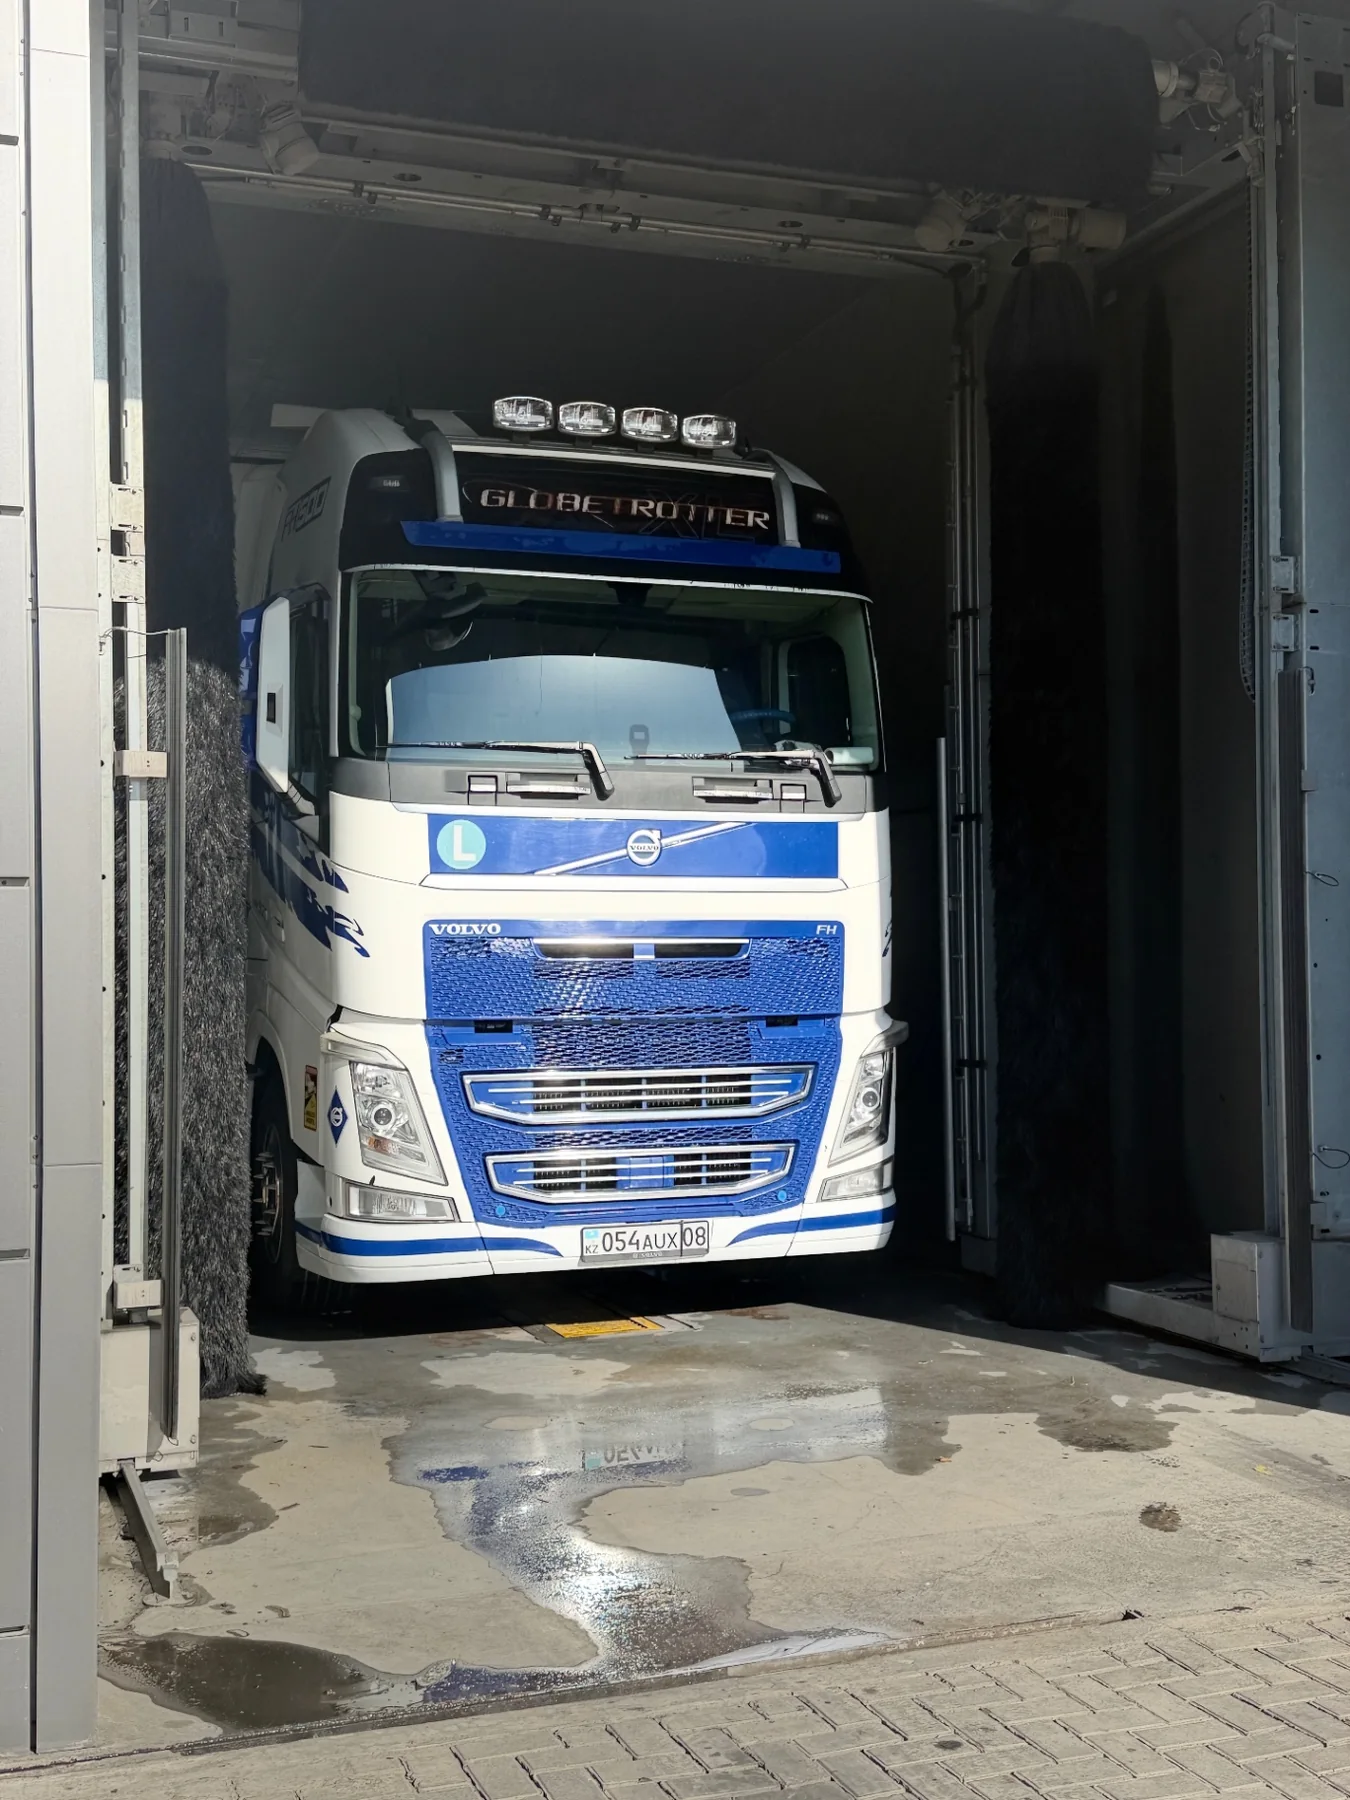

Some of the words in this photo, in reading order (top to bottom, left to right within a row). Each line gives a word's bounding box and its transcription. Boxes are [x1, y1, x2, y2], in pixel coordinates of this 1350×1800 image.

[480, 488, 770, 530] GLOBETROTTER
[453, 824, 476, 862] L
[429, 922, 502, 935] VOLVO
[816, 924, 837, 935] FH
[683, 1226, 706, 1247] 08
[585, 1244, 599, 1254] KZ
